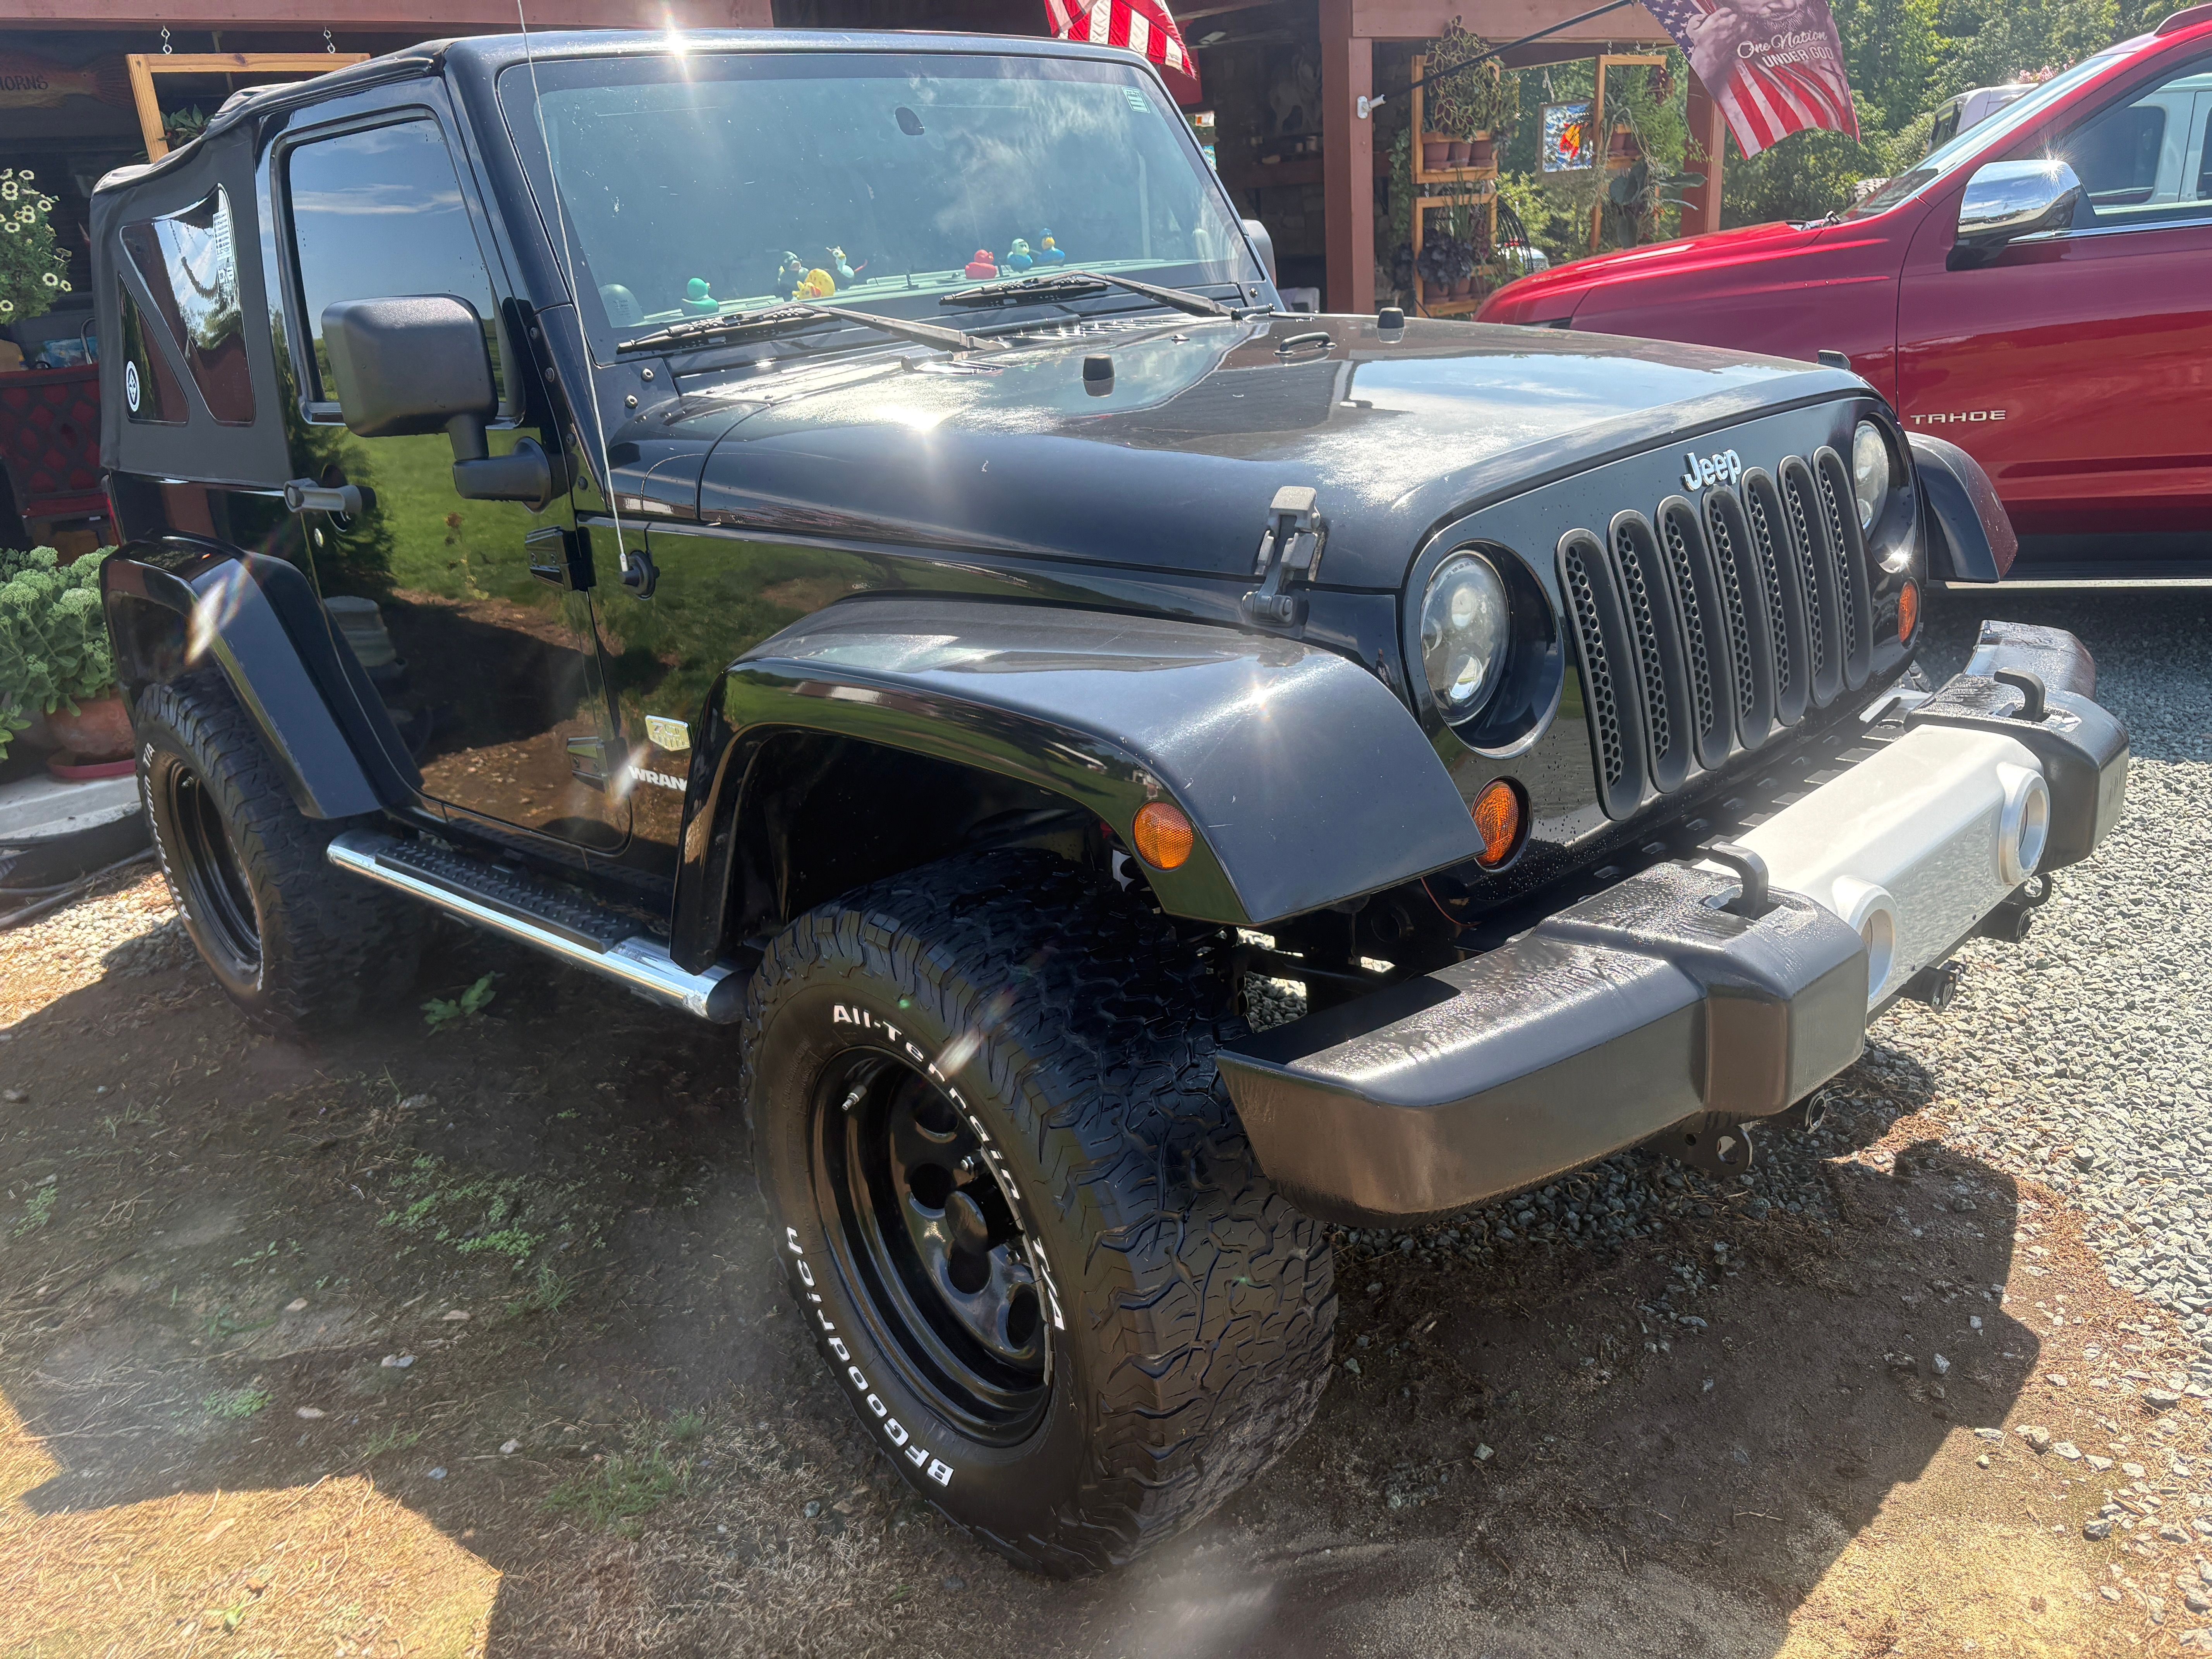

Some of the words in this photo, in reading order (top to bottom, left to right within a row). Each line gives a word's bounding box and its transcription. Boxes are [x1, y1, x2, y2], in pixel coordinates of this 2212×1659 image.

[1737, 41, 1771, 59] One
[1771, 30, 1827, 50] Nation
[1762, 50, 1809, 68] UNDER
[1809, 46, 1834, 60] GOD
[1910, 410, 2006, 425] TAHOE
[1680, 449, 1741, 492] Jeep
[143, 742, 156, 768] T/A
[833, 1004, 1020, 1200] All-Terrain
[1032, 1237, 1065, 1331] T/A
[786, 1226, 955, 1487] BFGoodrich
